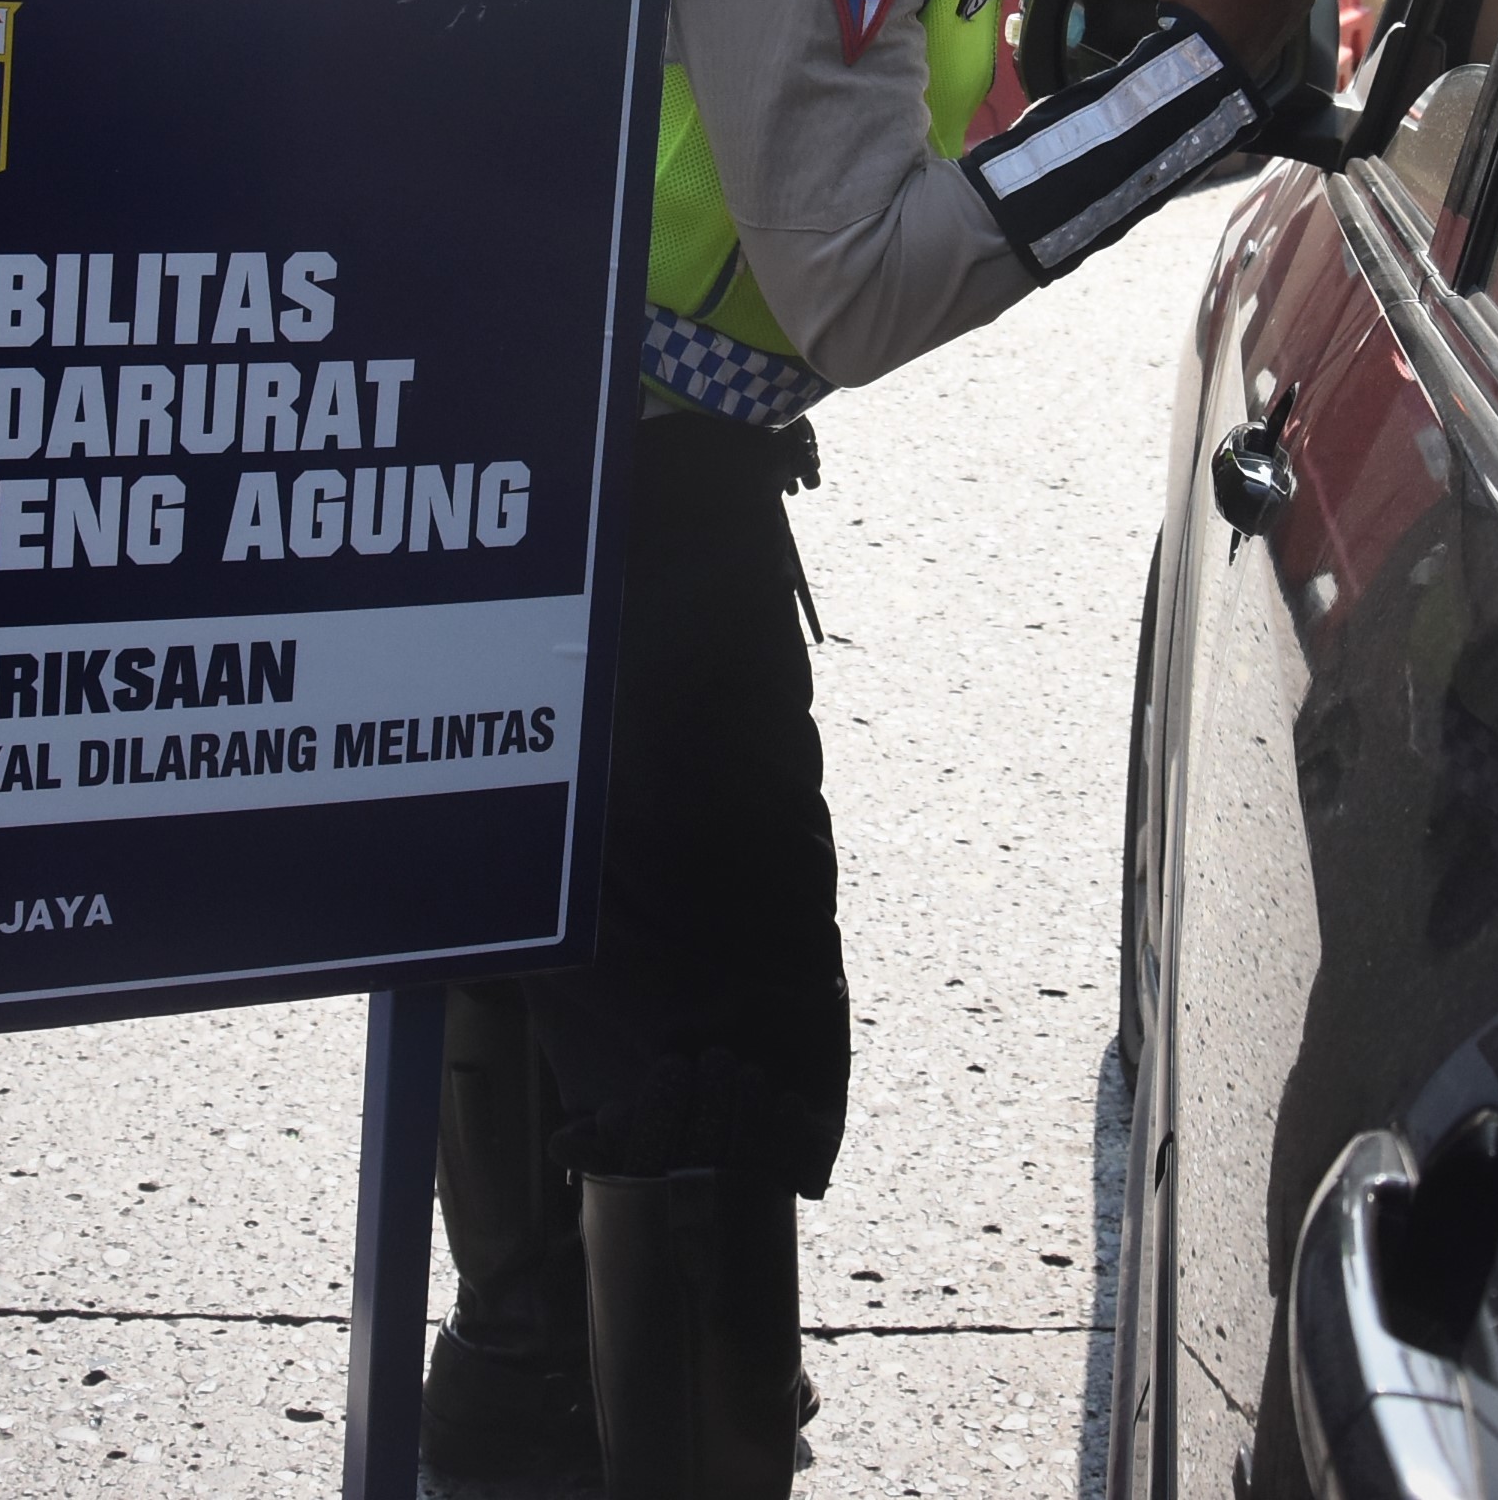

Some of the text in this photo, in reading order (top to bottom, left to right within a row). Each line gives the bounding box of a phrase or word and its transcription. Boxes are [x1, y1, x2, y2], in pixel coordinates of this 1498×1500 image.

[222, 460, 531, 562] AGUNG
[78, 725, 317, 787] DILARANG
[333, 706, 556, 770] MELINTAS
[0, 893, 113, 934] JAYA
